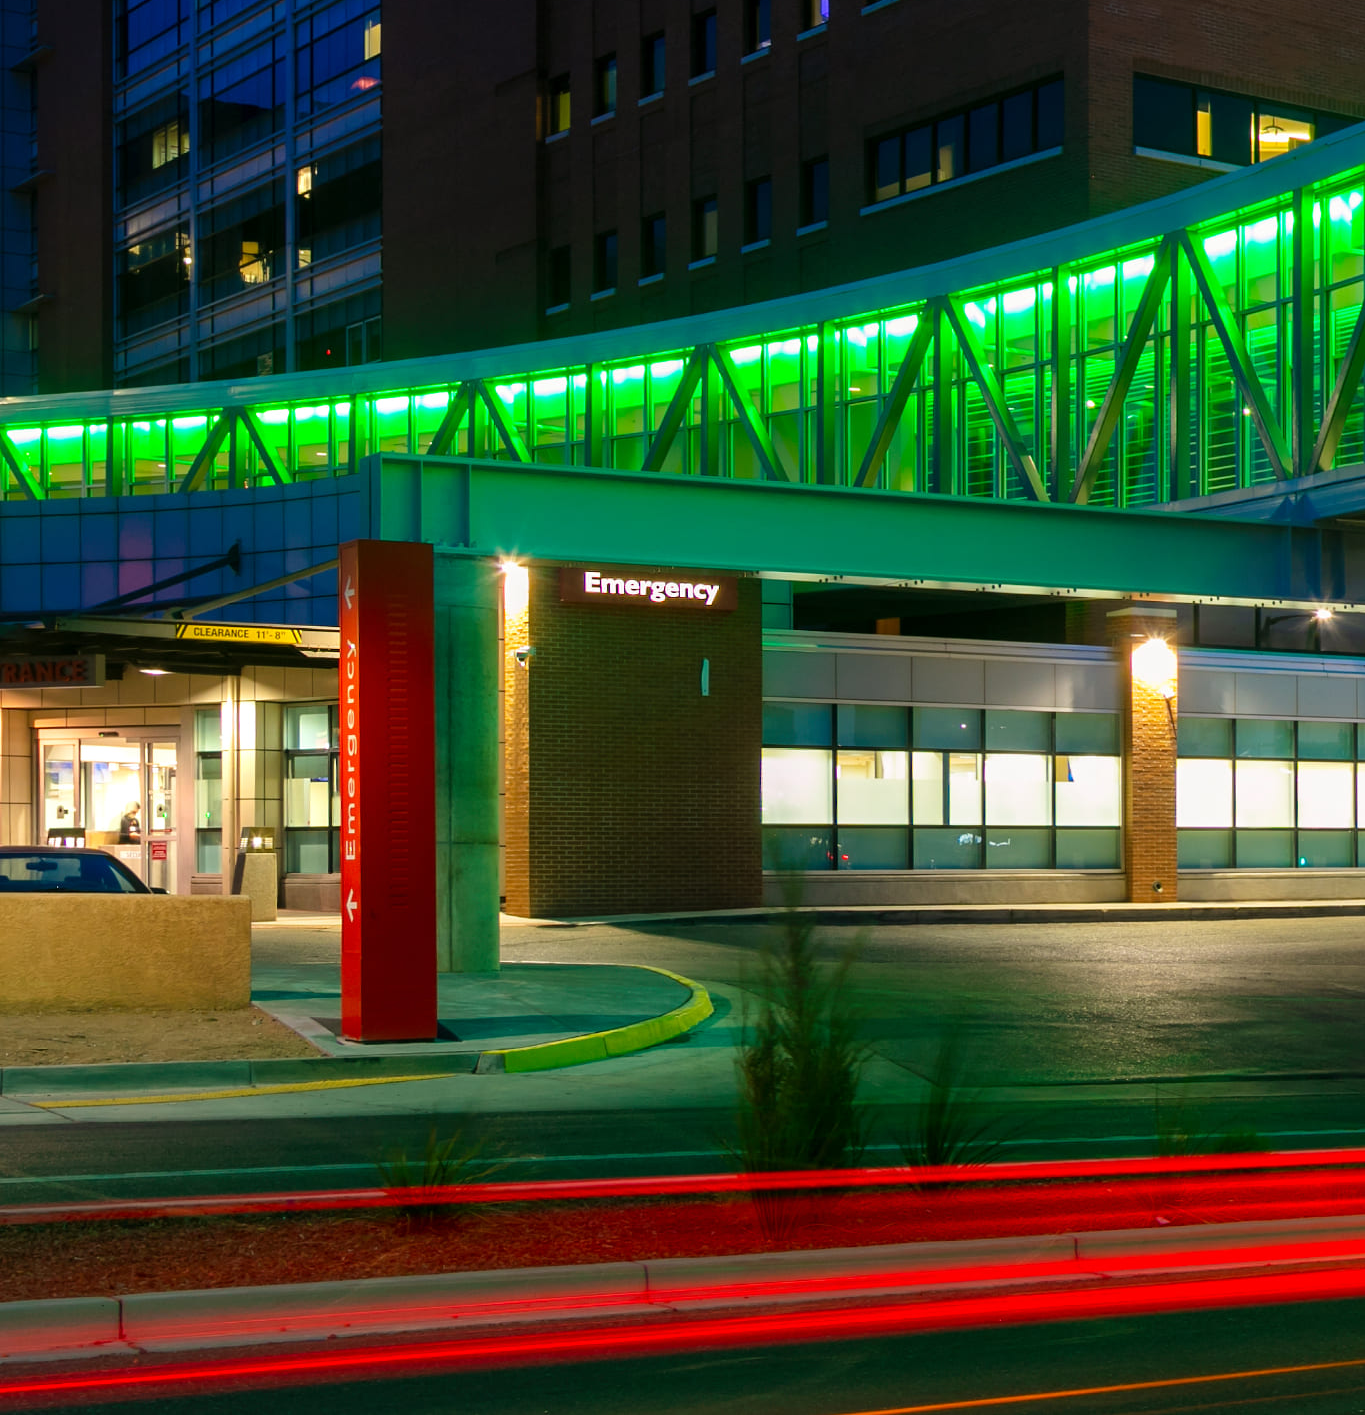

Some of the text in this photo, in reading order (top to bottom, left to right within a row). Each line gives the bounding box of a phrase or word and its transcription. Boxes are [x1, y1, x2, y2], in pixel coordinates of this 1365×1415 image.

[584, 571, 720, 606] Emergency
[193, 627, 249, 639] CLEARANCE
[345, 639, 358, 861] Emergency
